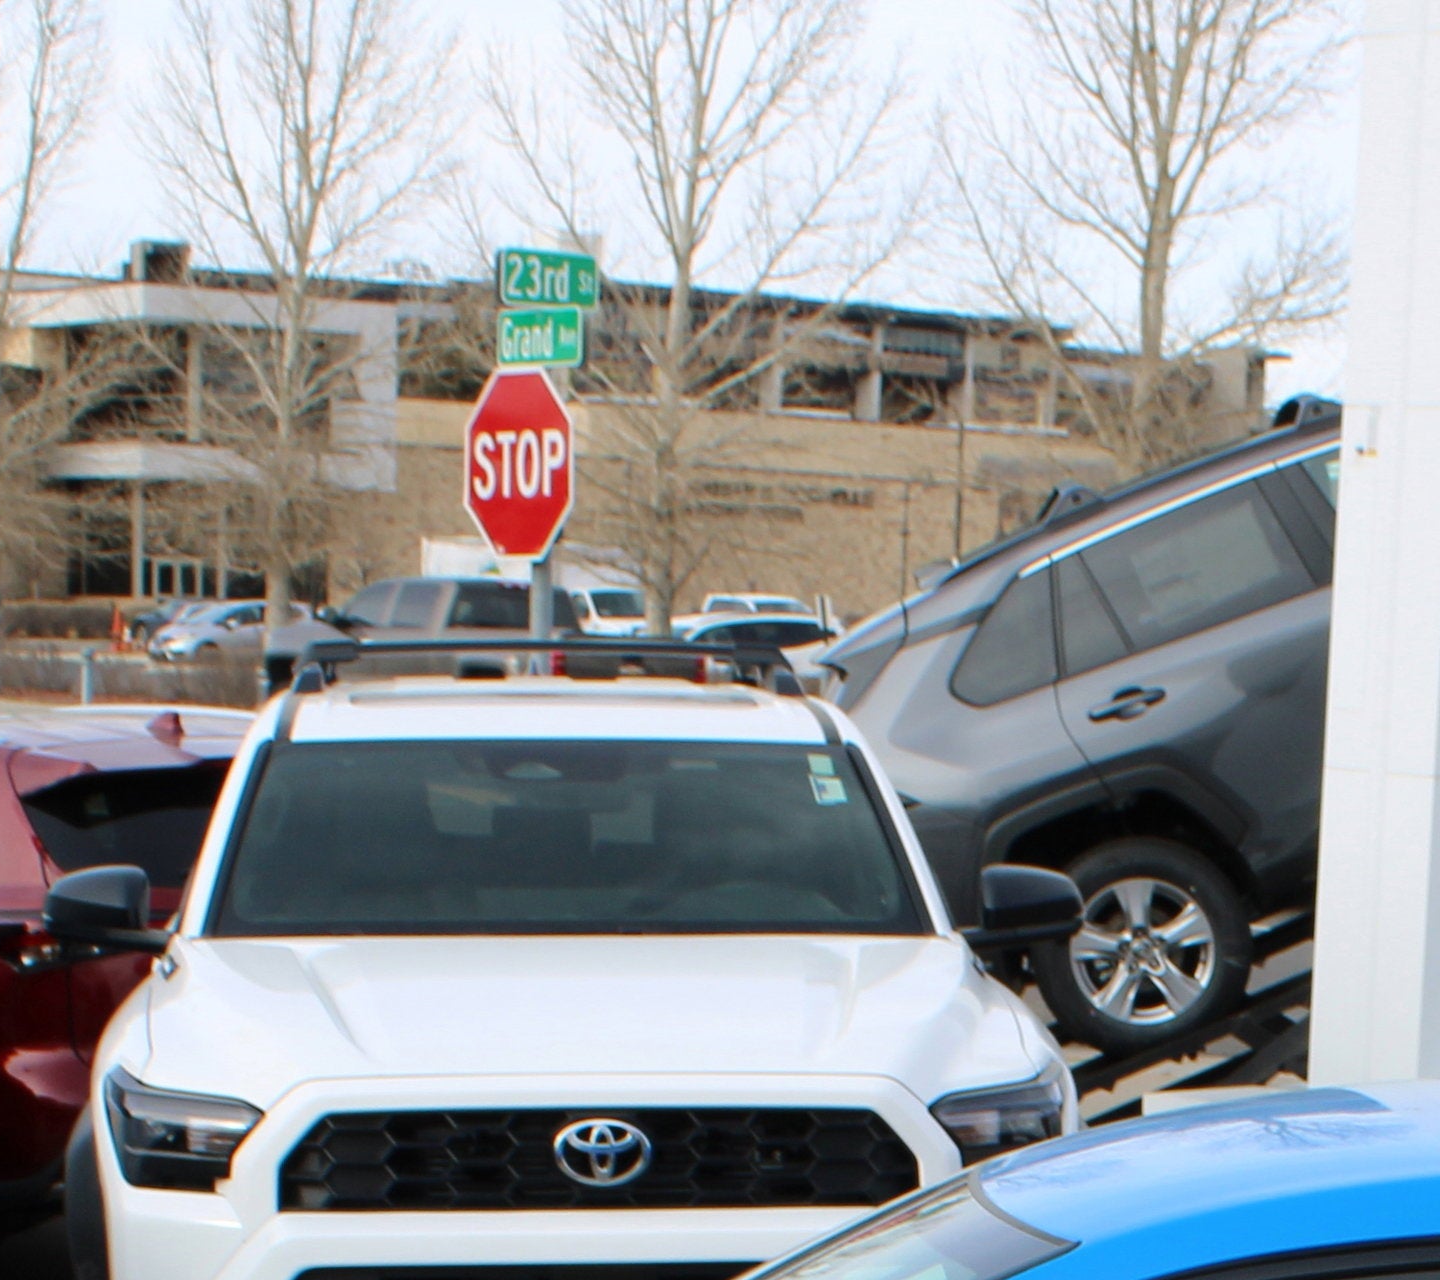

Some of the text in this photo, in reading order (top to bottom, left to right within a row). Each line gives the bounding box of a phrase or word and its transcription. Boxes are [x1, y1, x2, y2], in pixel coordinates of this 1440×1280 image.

[506, 253, 570, 302] 23rd
[501, 316, 554, 360] Grand
[472, 428, 566, 500] STOP
